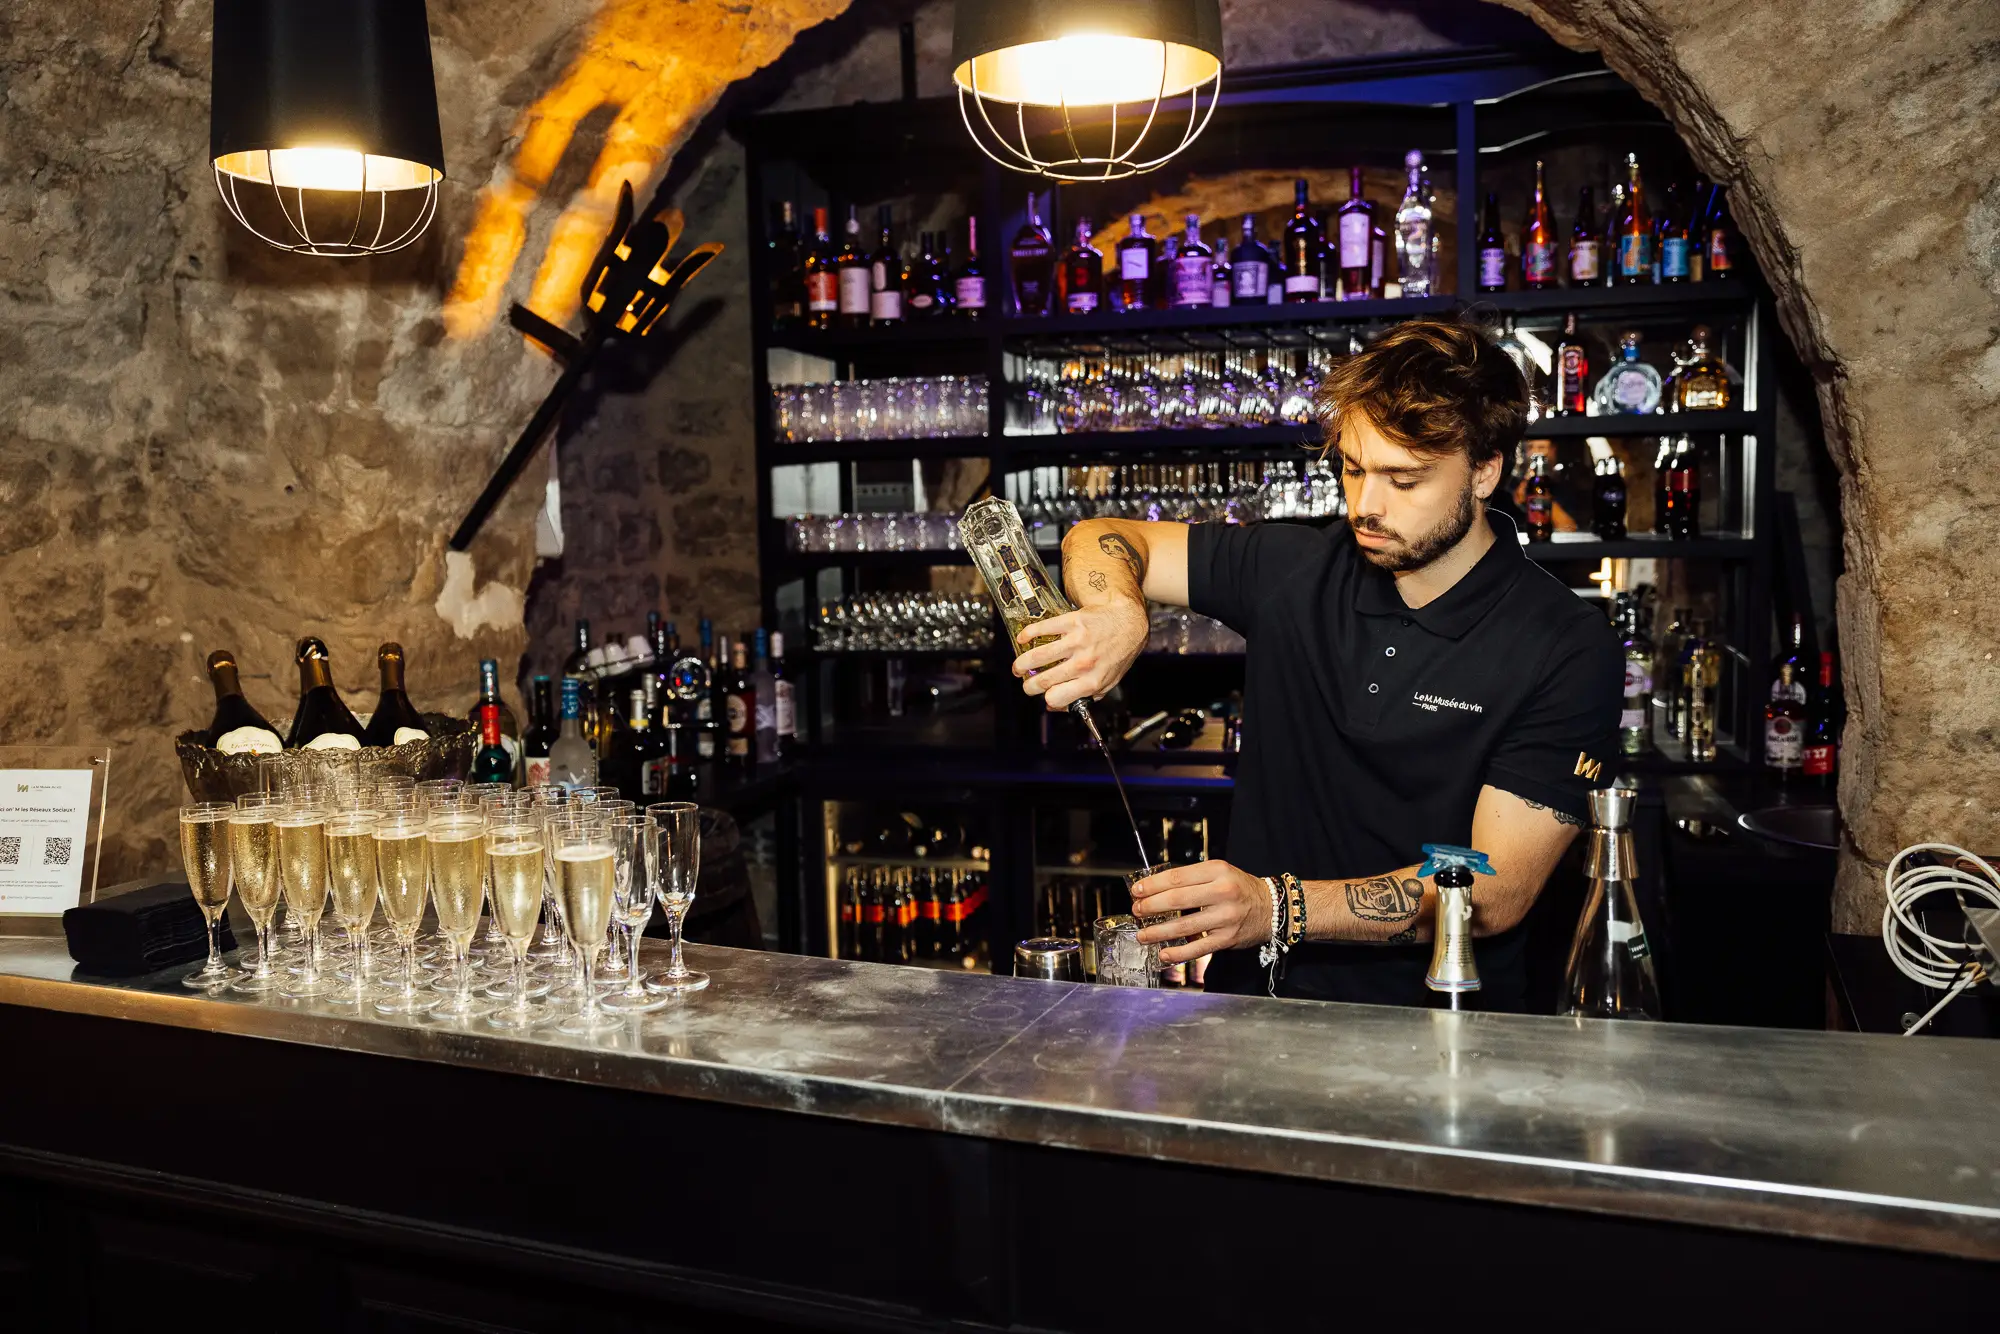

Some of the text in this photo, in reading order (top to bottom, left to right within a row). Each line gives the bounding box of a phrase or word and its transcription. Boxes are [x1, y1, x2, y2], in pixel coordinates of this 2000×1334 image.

[1413, 691, 1425, 701] Le
[1433, 695, 1459, 709] Musée
[1459, 701, 1470, 710] du
[1469, 703, 1483, 713] vin
[1421, 703, 1439, 712] PARIS
